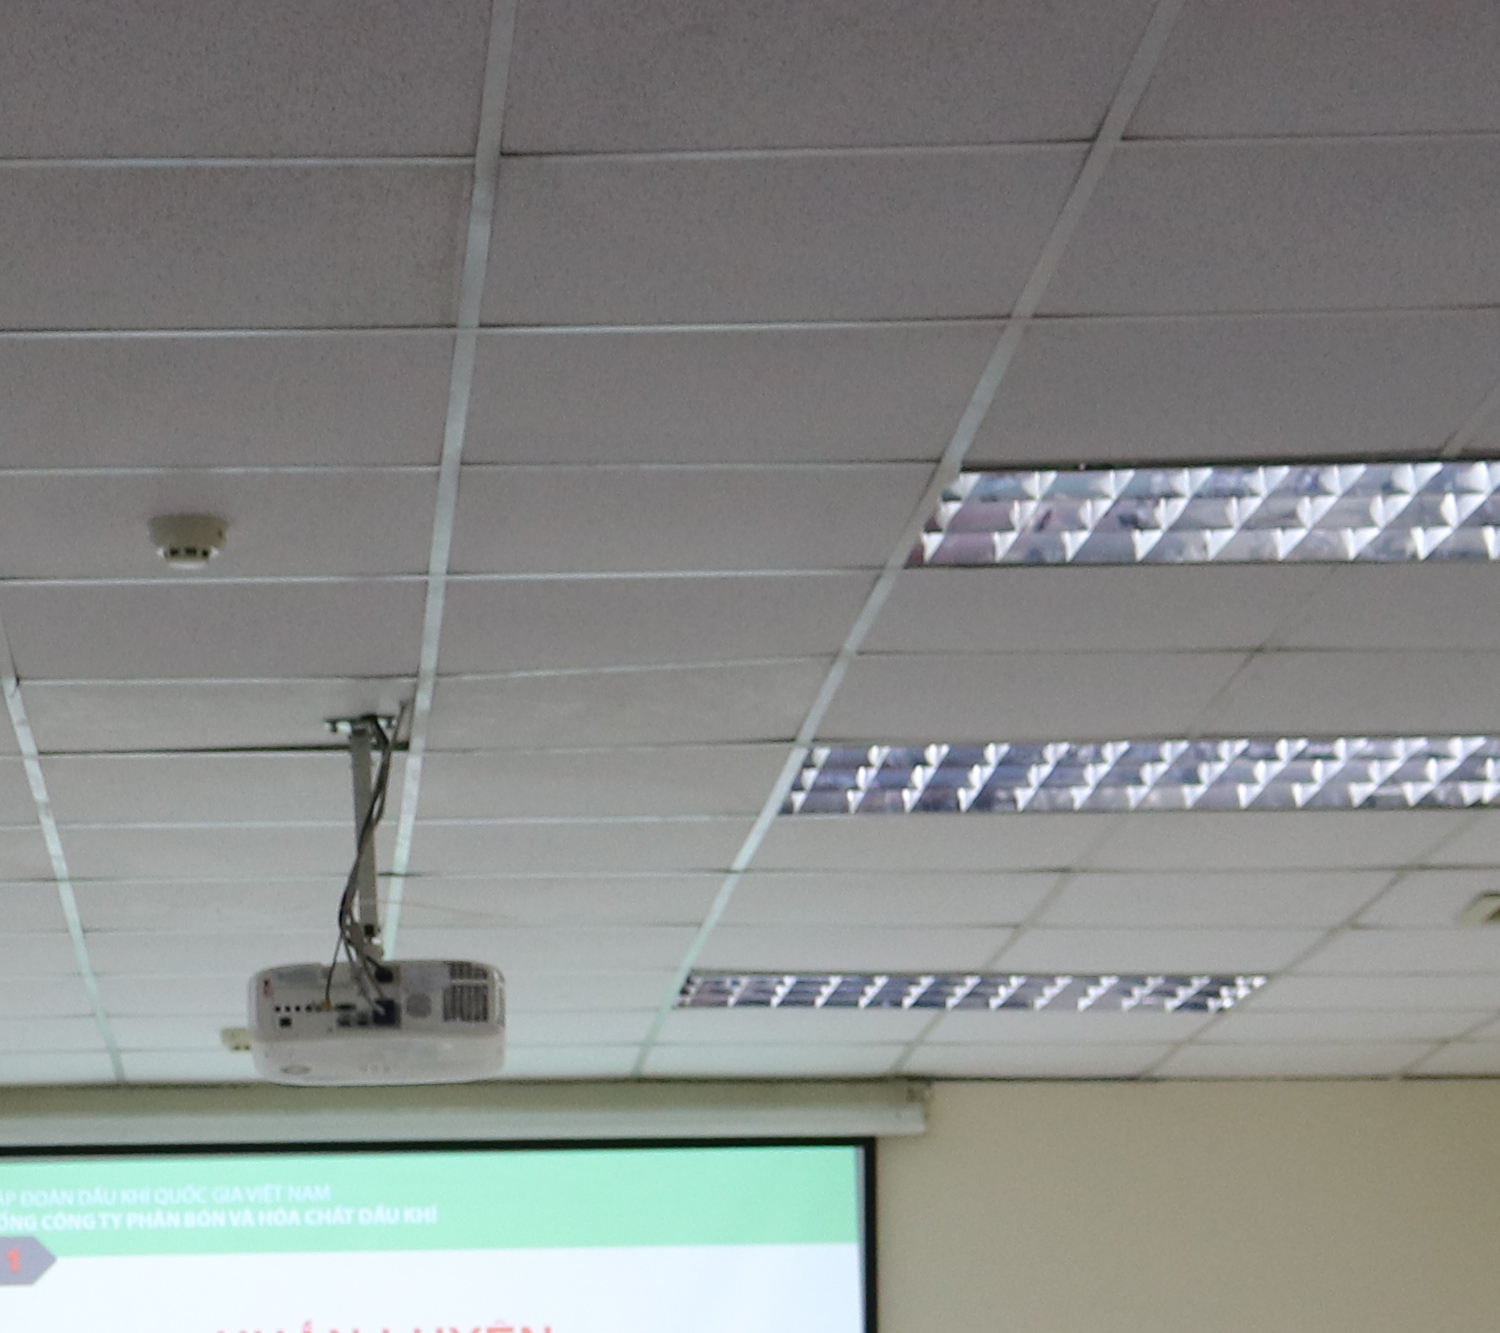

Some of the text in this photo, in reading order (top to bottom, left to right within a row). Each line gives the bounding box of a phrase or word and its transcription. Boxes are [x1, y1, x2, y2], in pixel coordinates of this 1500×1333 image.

[286, 1183, 331, 1204] NAM
[98, 1211, 123, 1230] TY
[5, 1248, 22, 1274] 1
